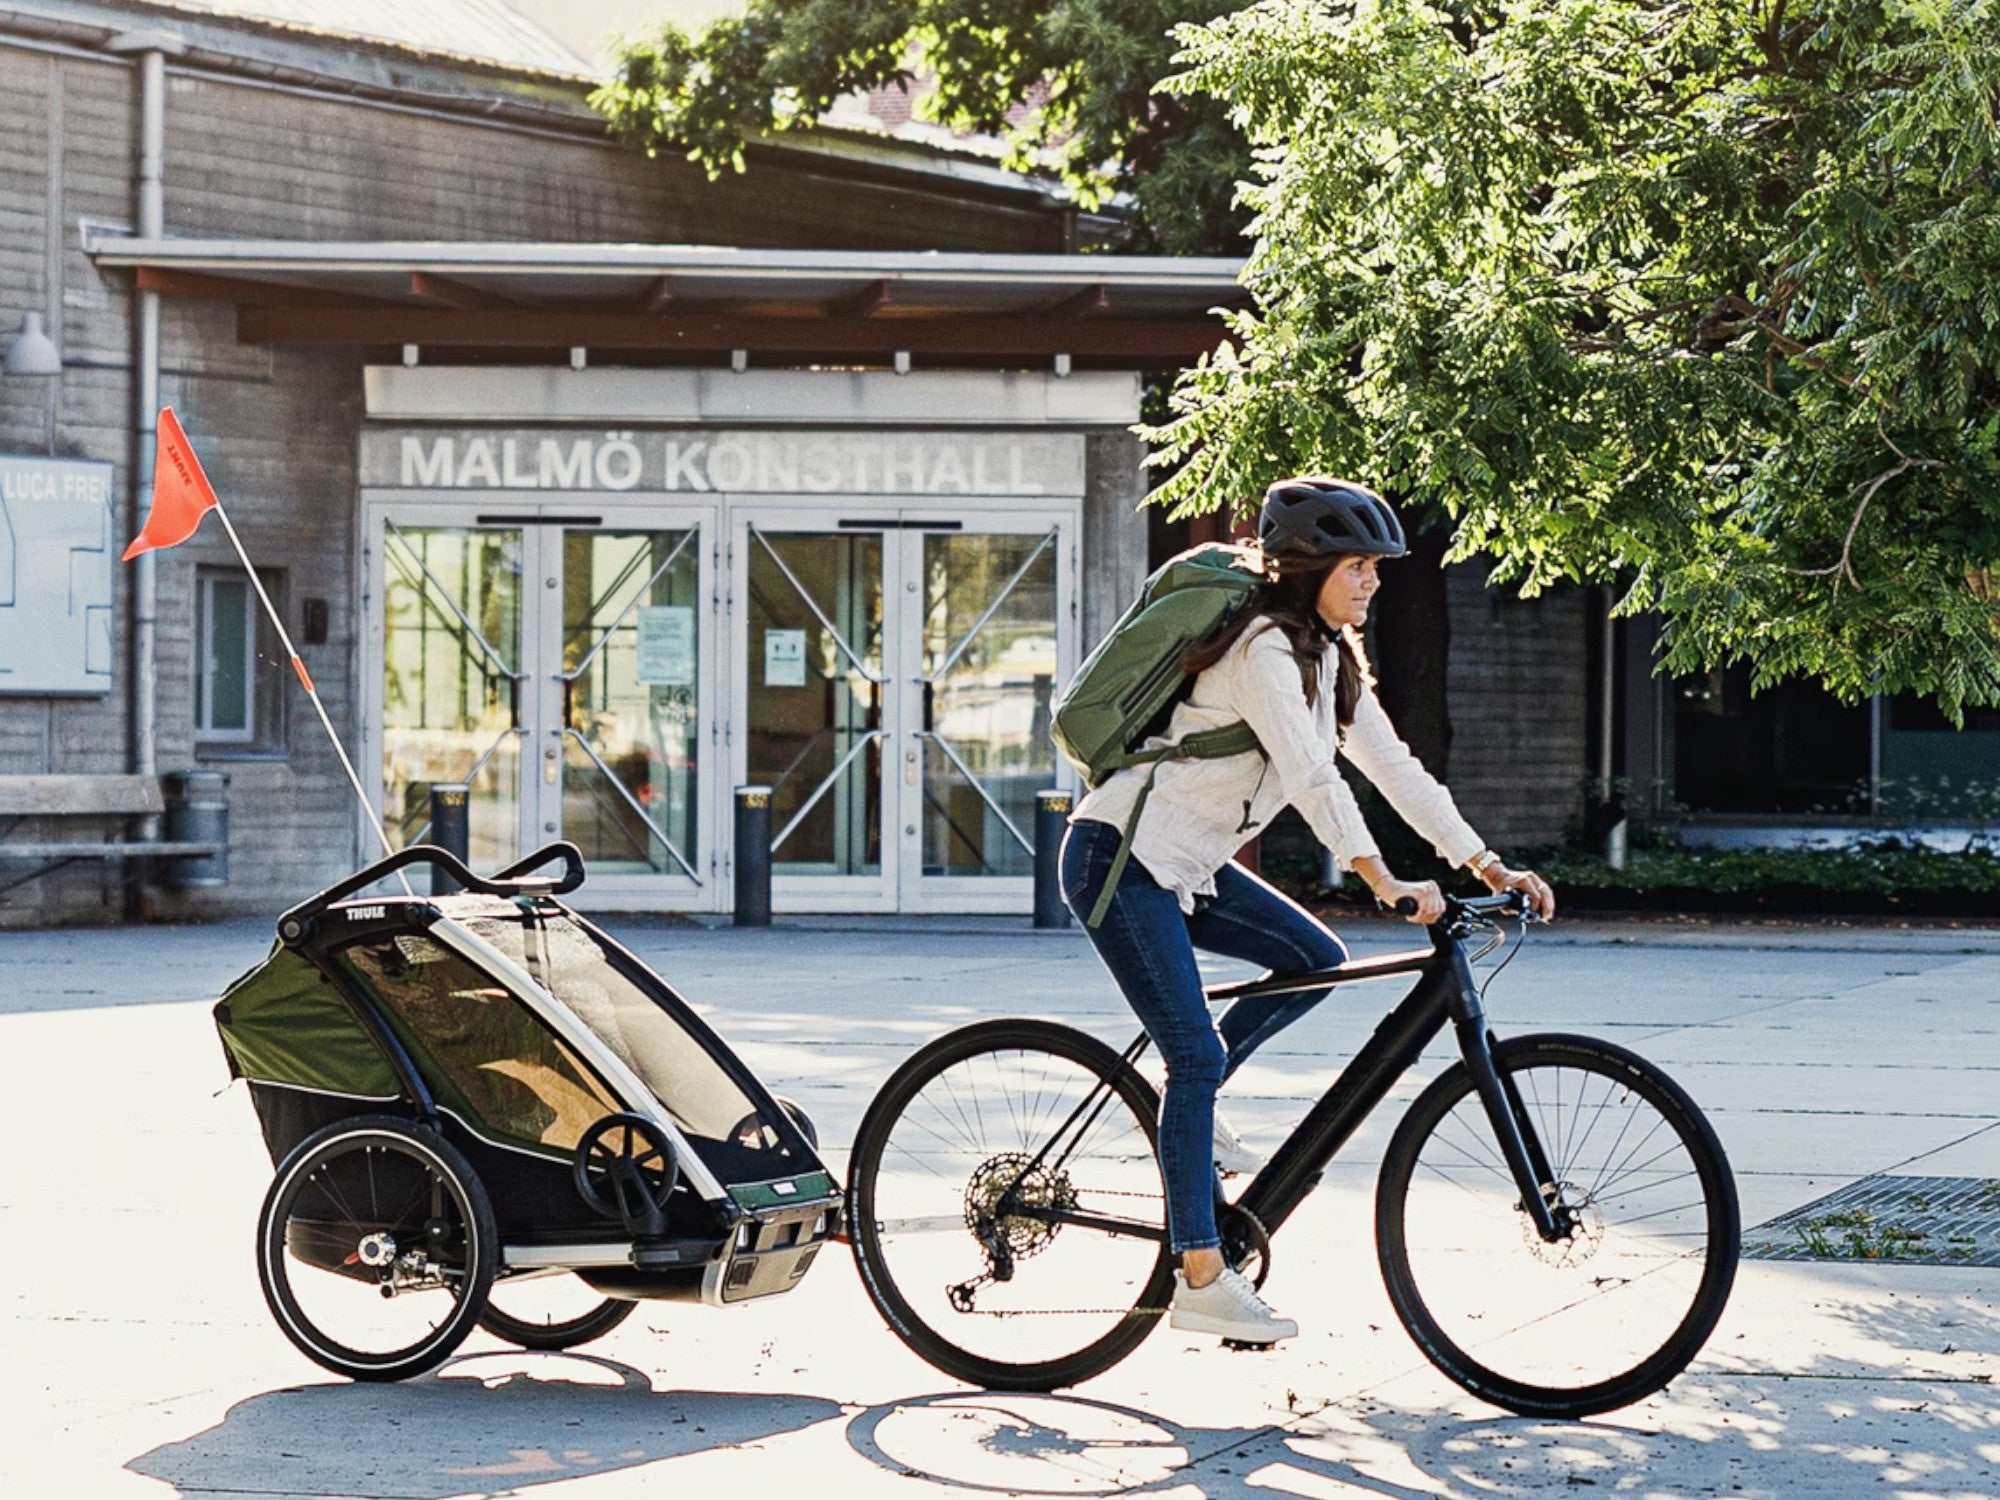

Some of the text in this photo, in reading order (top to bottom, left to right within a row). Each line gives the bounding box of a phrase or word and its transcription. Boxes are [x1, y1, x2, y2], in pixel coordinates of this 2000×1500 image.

[401, 431, 1043, 495] MALMÖ KONSTHALL
[4, 469, 57, 501] LUCA
[346, 906, 386, 921] THULE
